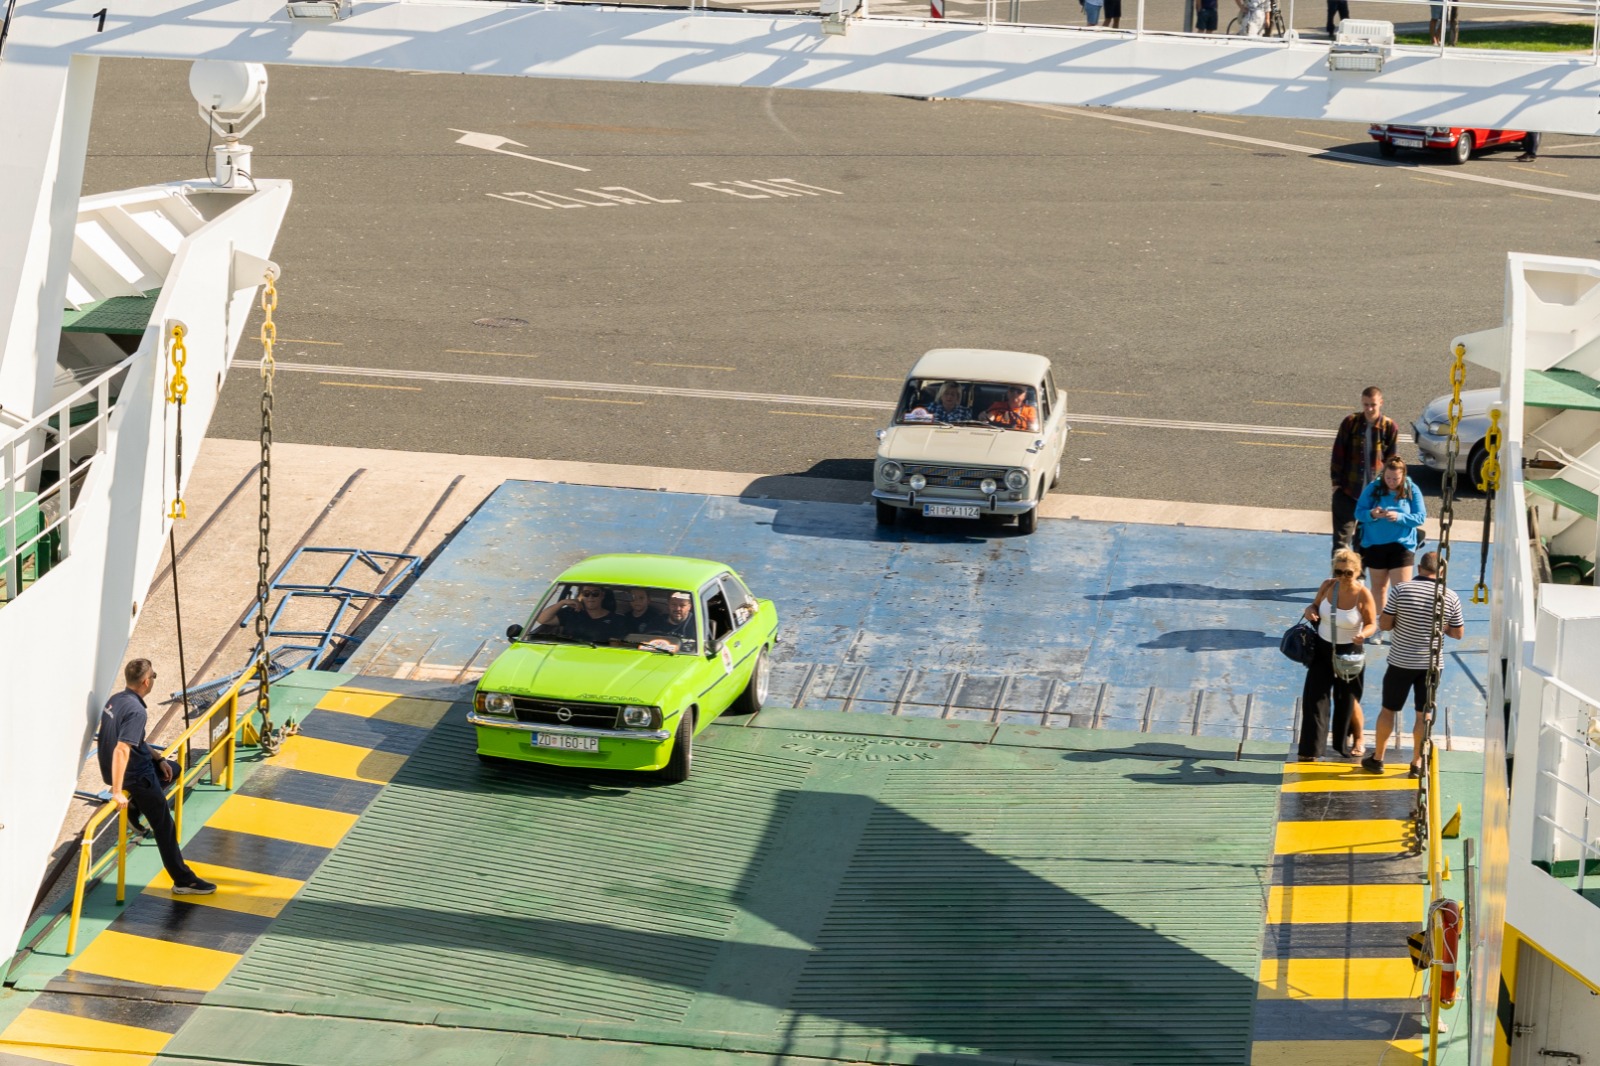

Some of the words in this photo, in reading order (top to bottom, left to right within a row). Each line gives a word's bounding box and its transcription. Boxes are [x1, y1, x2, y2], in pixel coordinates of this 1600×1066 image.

[92, 8, 107, 32] 1
[485, 186, 683, 209] IZLAZ
[688, 177, 844, 200] EXIT
[560, 736, 597, 750] 160-LP
